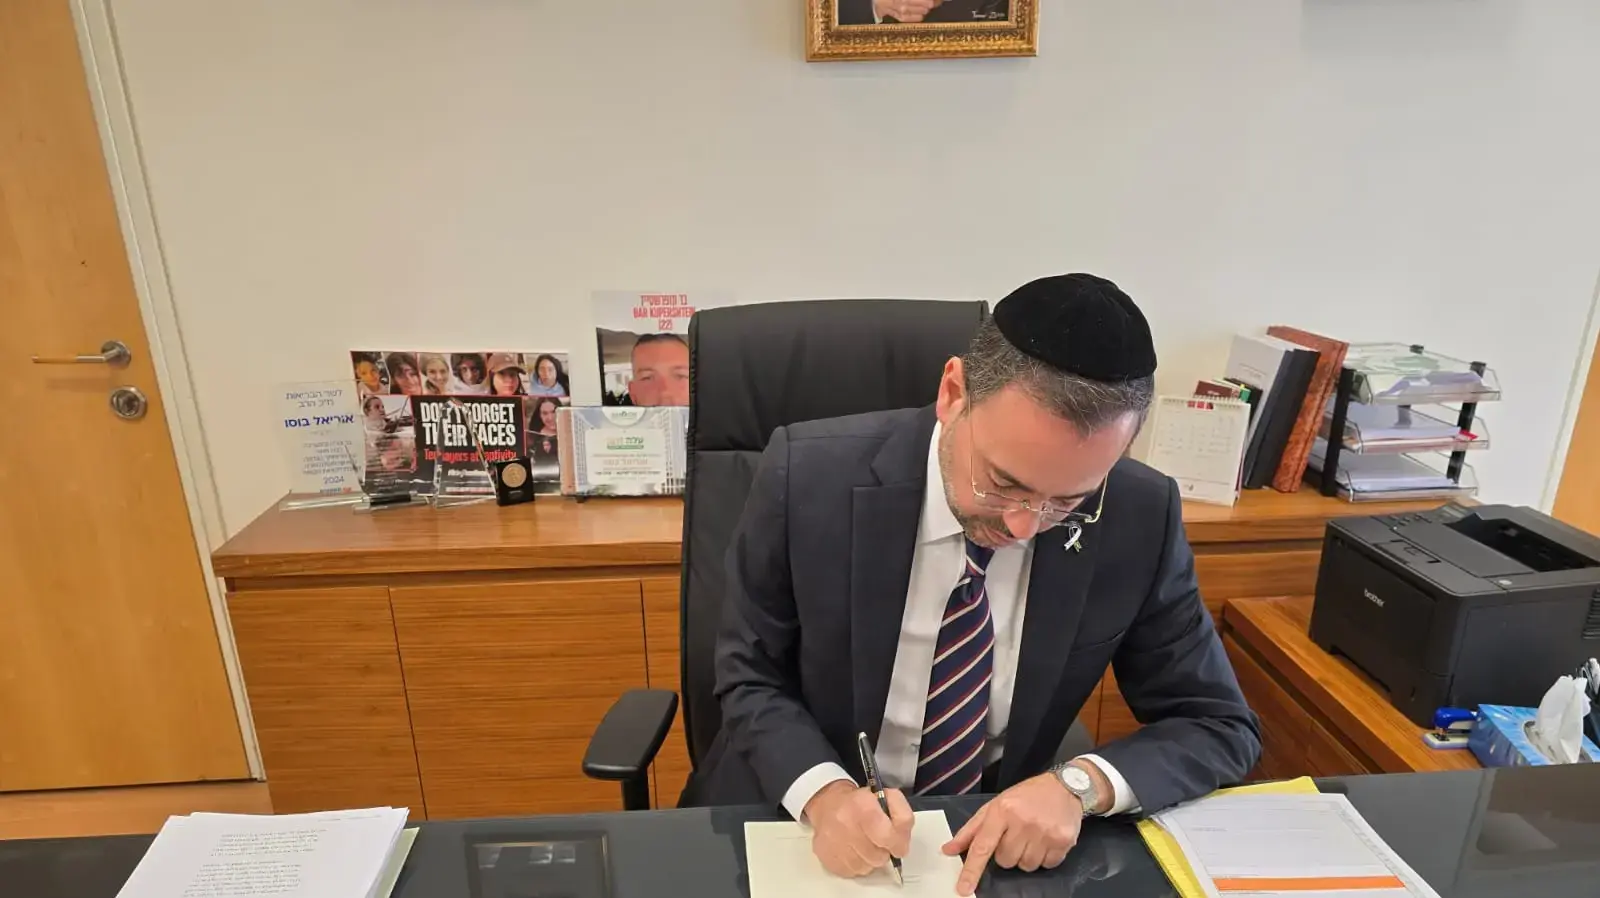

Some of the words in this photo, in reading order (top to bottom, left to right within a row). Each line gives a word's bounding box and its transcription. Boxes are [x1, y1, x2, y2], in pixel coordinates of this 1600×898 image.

[633, 307, 648, 318] BAR
[285, 418, 310, 428] בוסו
[313, 414, 354, 425] אוריאל
[484, 449, 517, 462] aptivity
[323, 476, 344, 484] 2024
